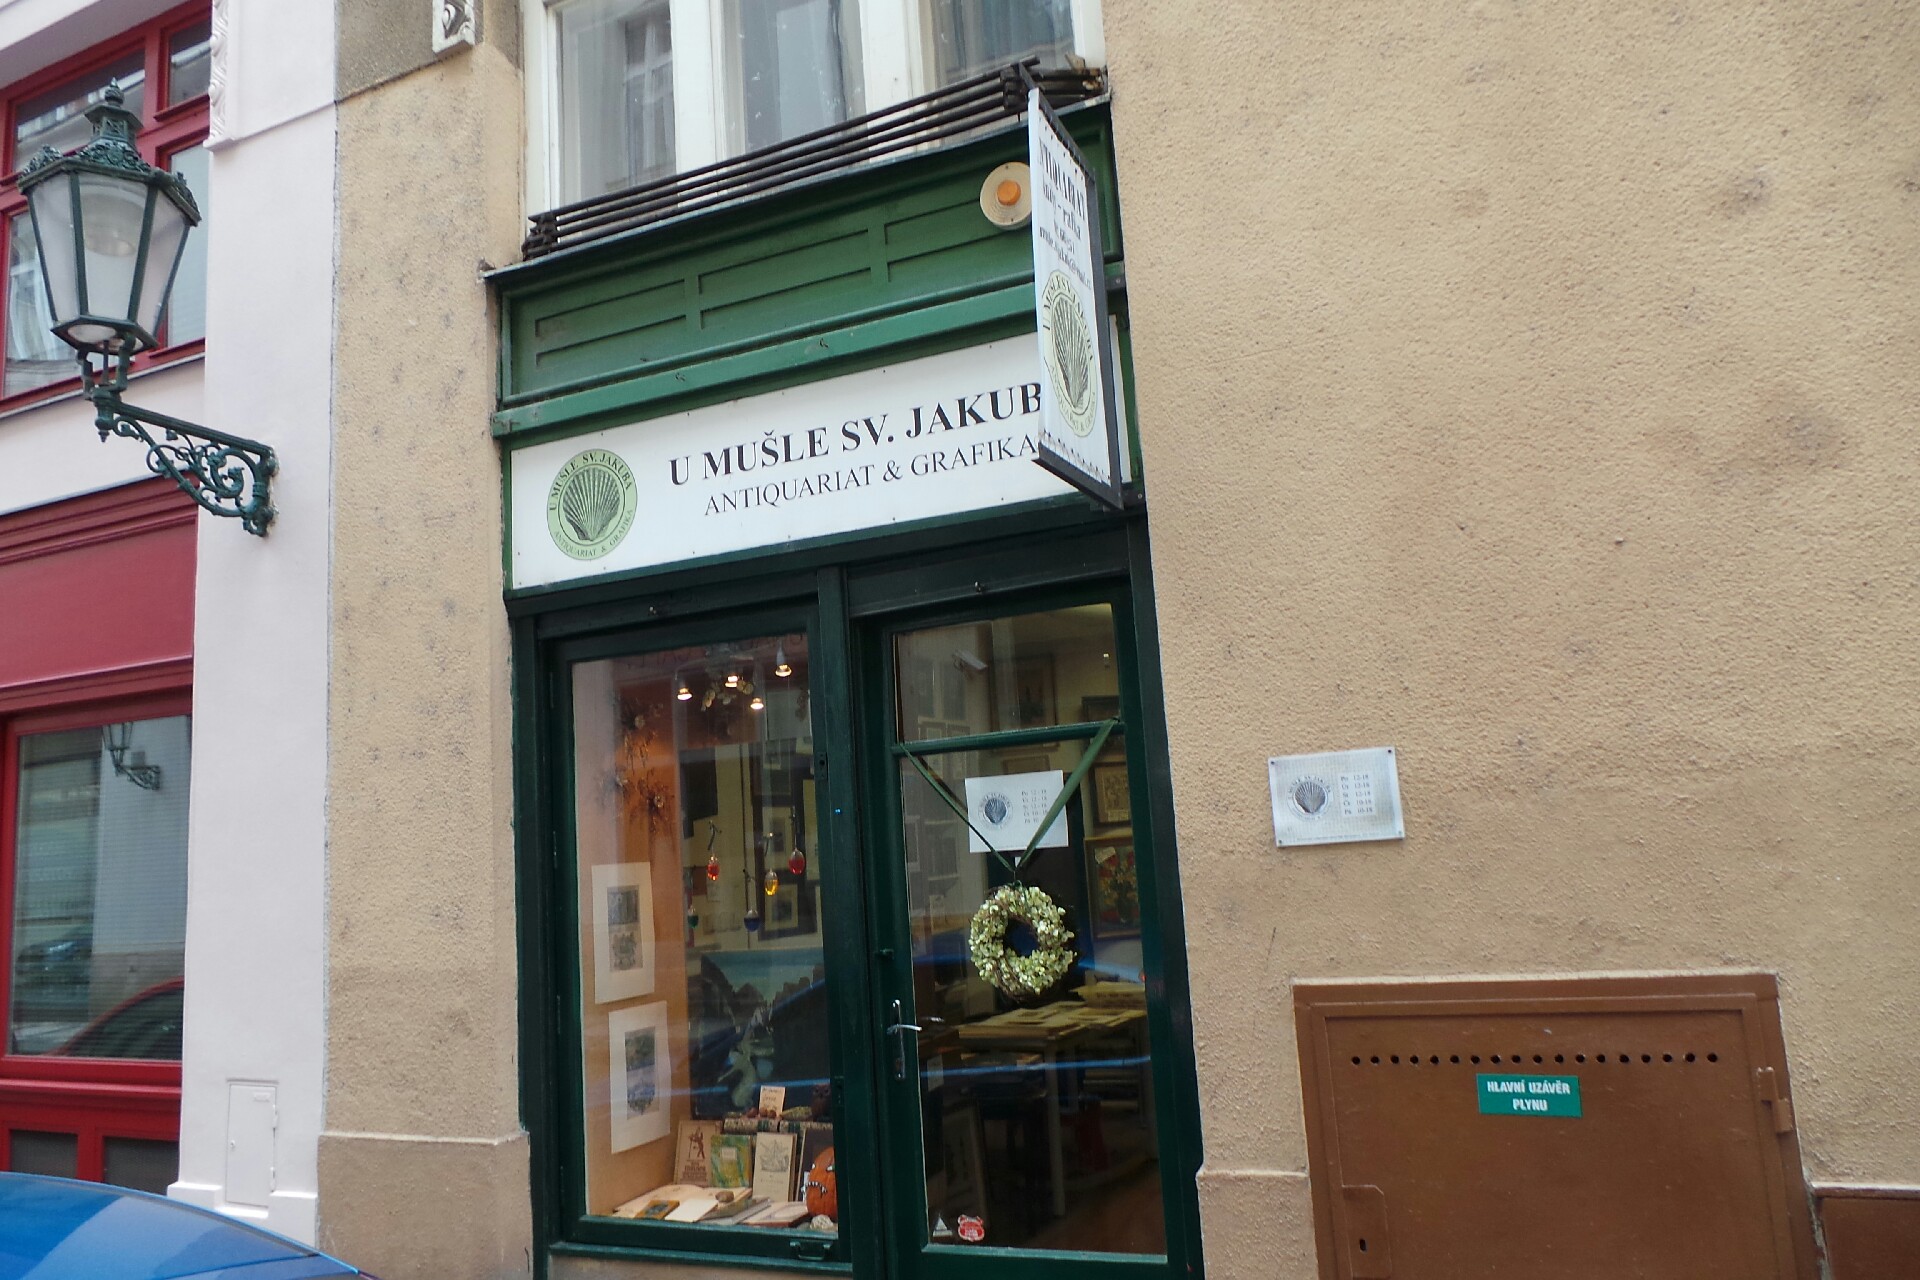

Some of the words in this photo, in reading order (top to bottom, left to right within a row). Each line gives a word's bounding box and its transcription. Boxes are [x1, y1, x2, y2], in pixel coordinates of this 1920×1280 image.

[668, 455, 692, 486] U
[702, 429, 830, 480] MUŠLE
[841, 414, 894, 451] SV.
[704, 464, 875, 516] ANTIQUARIAT
[883, 459, 903, 482] &
[911, 434, 1038, 476] GRAFIKA
[549, 502, 557, 511] U
[599, 453, 632, 490] JAKUBA
[554, 530, 597, 557] ANTIQUARIAT
[609, 509, 633, 546] GRAFIKA
[1486, 1079, 1526, 1093] HLAVNÍ
[1528, 1080, 1571, 1095] UZÁVĚR
[1512, 1098, 1548, 1111] PLYNU
